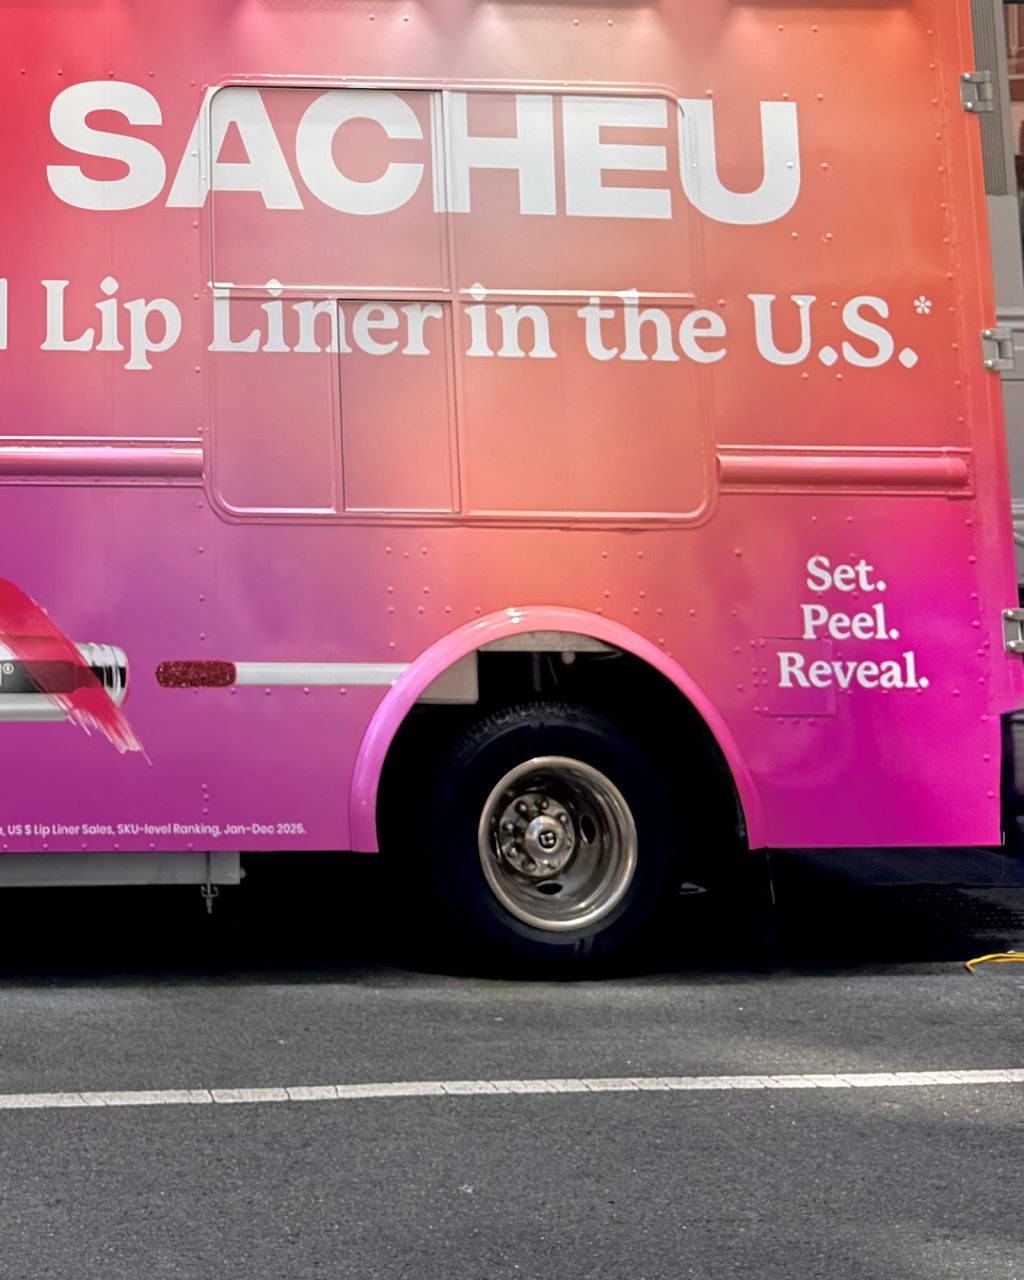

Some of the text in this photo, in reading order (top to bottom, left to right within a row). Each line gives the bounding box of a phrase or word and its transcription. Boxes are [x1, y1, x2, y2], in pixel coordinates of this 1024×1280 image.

[46, 80, 801, 225] SACHEU
[40, 275, 182, 370] Lip
[207, 277, 443, 355] Liner
[466, 282, 558, 358] in
[577, 288, 727, 364] the
[806, 555, 887, 592] Set.
[800, 602, 900, 640] Peel.
[777, 650, 930, 689] Reveal.
[7, 824, 22, 836] US
[33, 823, 51, 838] Lip
[52, 823, 80, 835] Liner
[81, 823, 116, 836] Sales,
[117, 823, 171, 835] SKU-level
[173, 823, 222, 838] Ranking,
